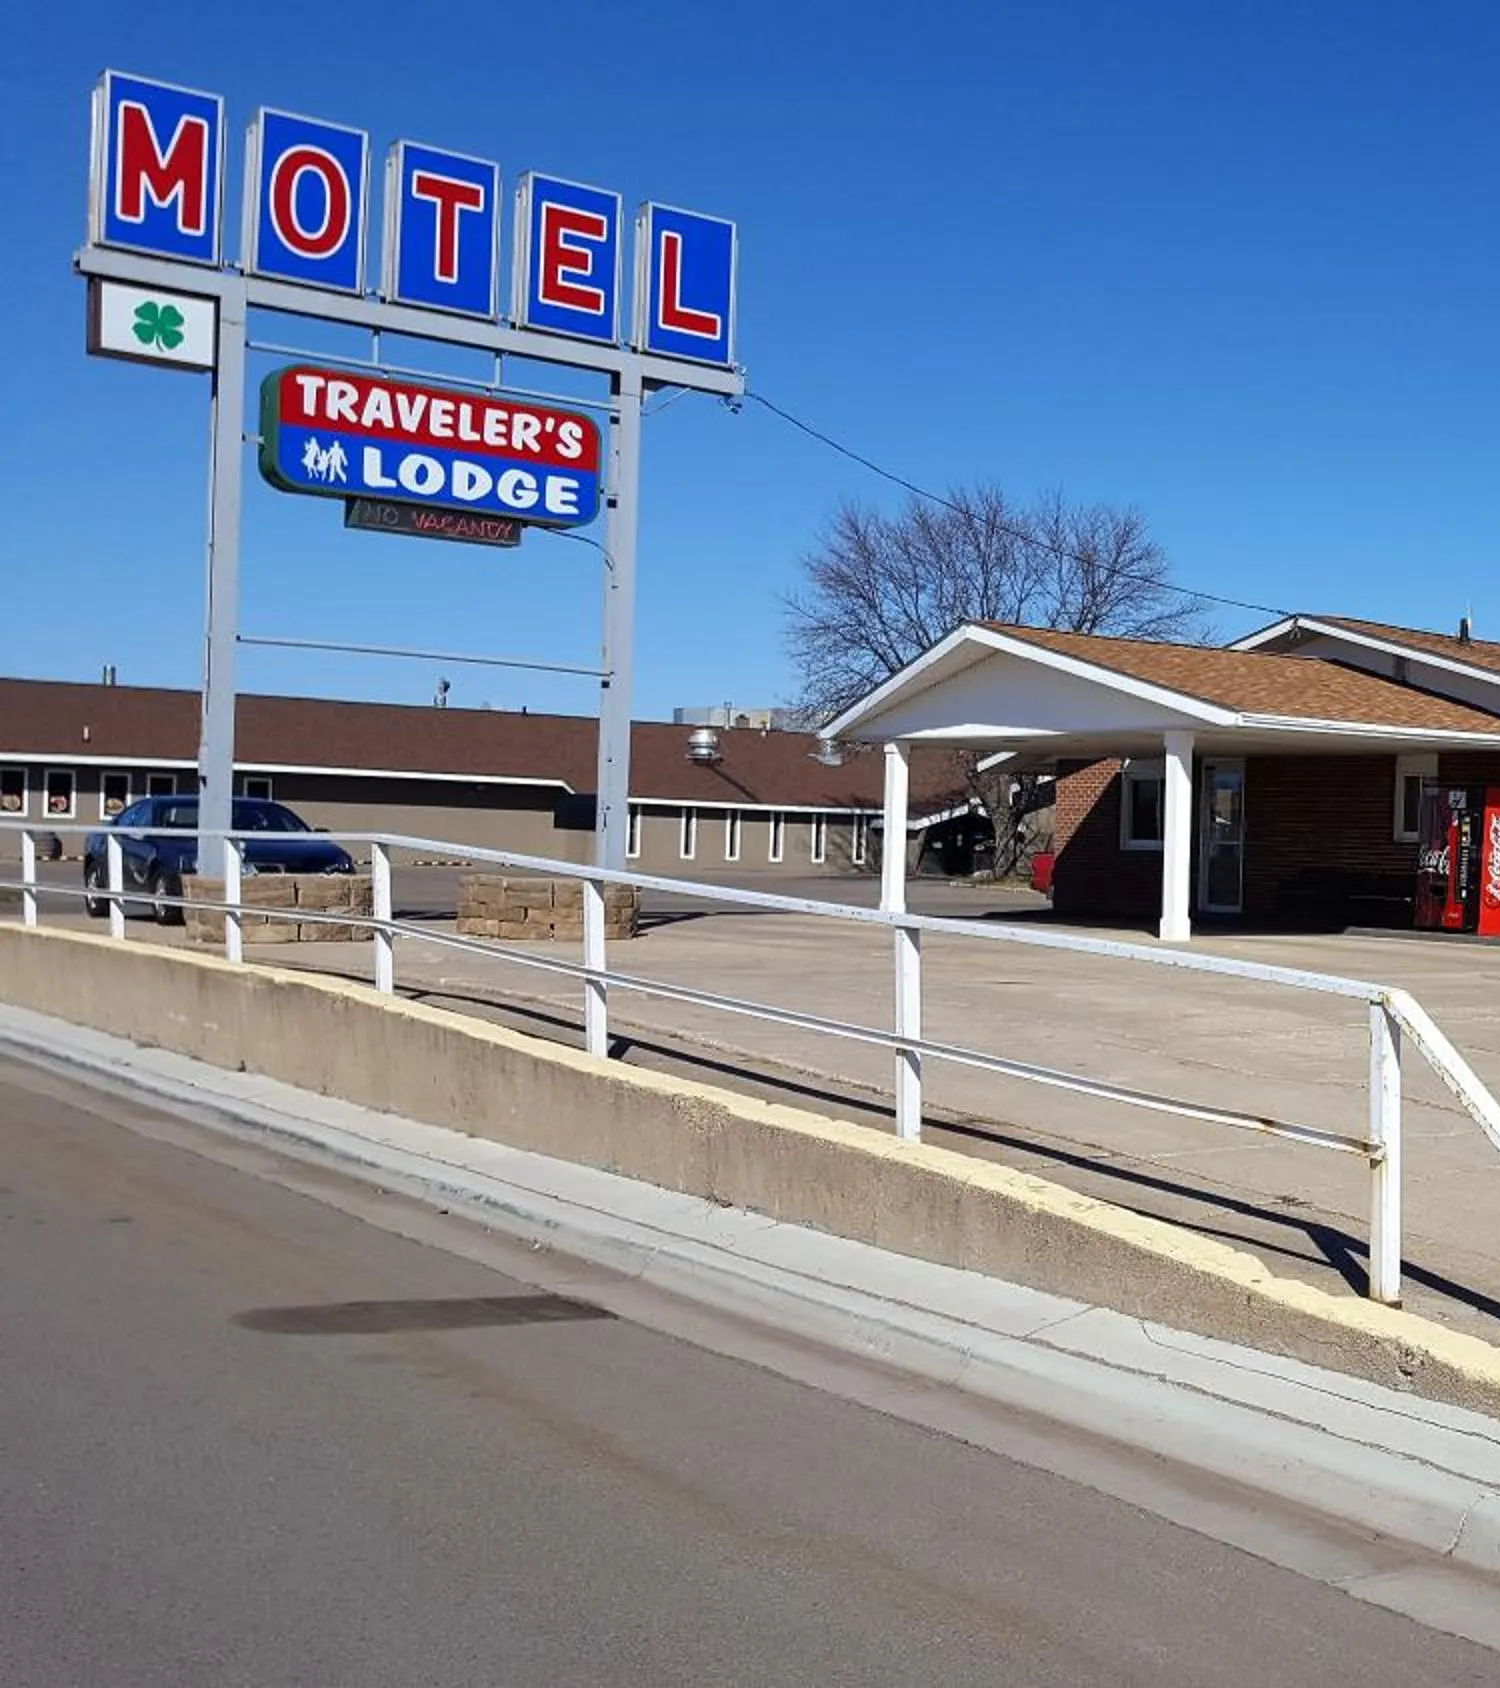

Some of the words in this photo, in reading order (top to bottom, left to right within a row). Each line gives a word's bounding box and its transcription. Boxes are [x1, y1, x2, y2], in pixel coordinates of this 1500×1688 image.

[116, 101, 721, 340] MOTEL
[296, 375, 583, 459] TRAVELER'S
[363, 446, 580, 515] LODGE
[366, 501, 399, 525] NO
[412, 511, 513, 538] VACANCY
